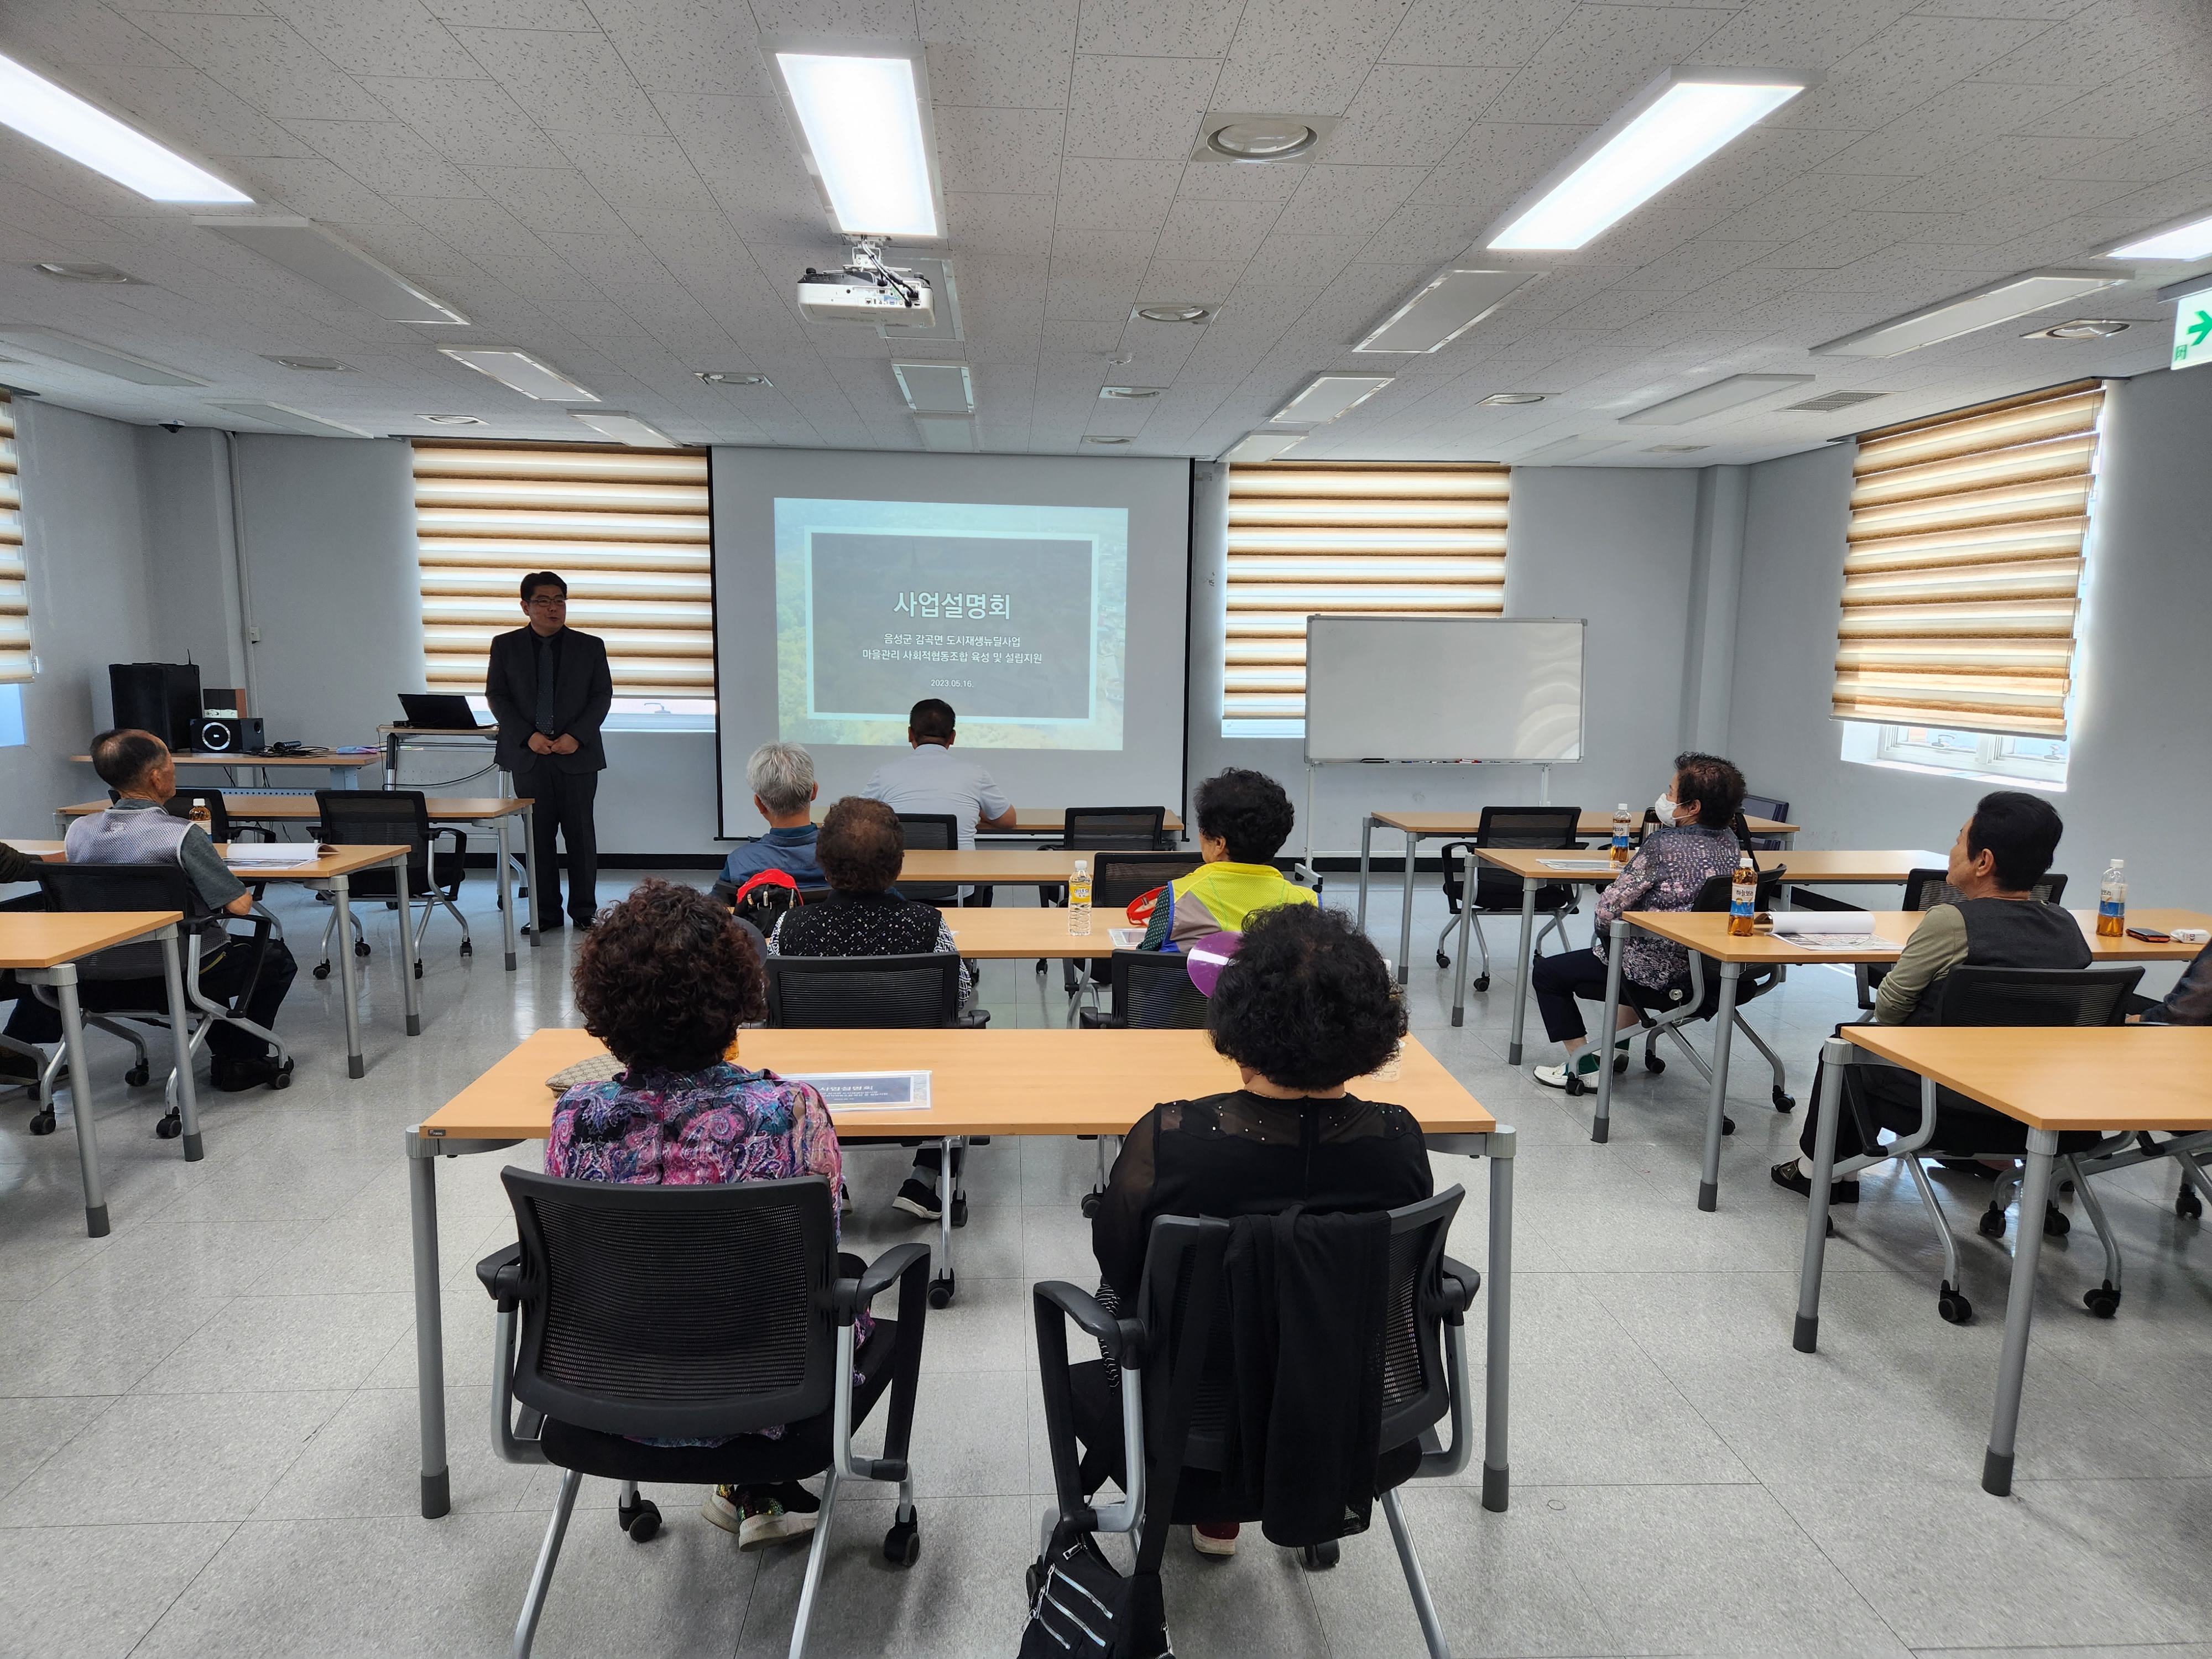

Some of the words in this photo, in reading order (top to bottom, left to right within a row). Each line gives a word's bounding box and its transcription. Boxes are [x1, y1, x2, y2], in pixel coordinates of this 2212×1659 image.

[893, 591, 1011, 619] 사업설명회
[884, 633, 912, 645] 음성군
[915, 634, 943, 646] 감곡면
[946, 635, 1021, 647] 도시재생뉴딜사업
[863, 649, 899, 661] 마을관리
[902, 650, 968, 662] 사회적협동조합
[971, 651, 990, 663] 육성
[993, 652, 1002, 664] 및
[1005, 653, 1042, 664] 설립지원
[931, 679, 974, 688] 2023.05.16.
